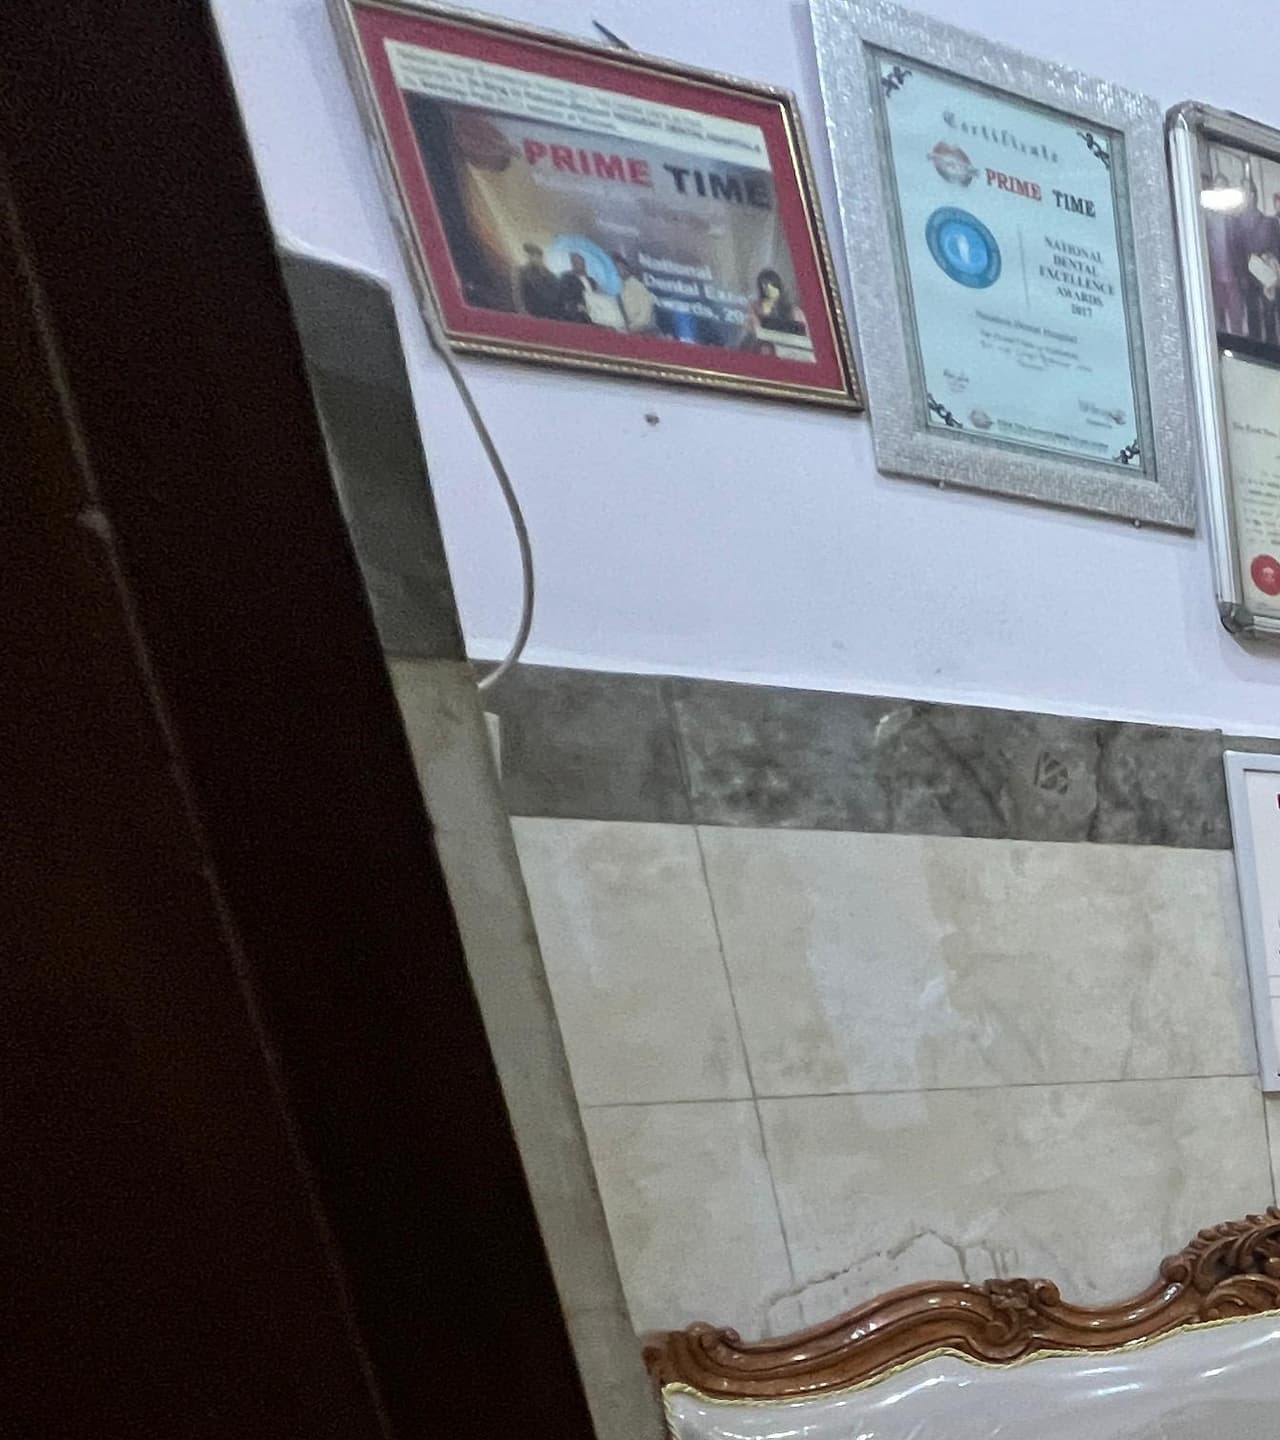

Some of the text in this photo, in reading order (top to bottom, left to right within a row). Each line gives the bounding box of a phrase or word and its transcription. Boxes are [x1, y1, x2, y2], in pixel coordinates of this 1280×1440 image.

[522, 138, 775, 210] PRIME TIME
[985, 168, 1096, 218] PRIME TIME
[1044, 235, 1104, 263] NATIONAL
[1039, 265, 1116, 296] EXCELLENCE
[1053, 255, 1099, 277] DENTAL
[1056, 286, 1104, 307] AWARDS
